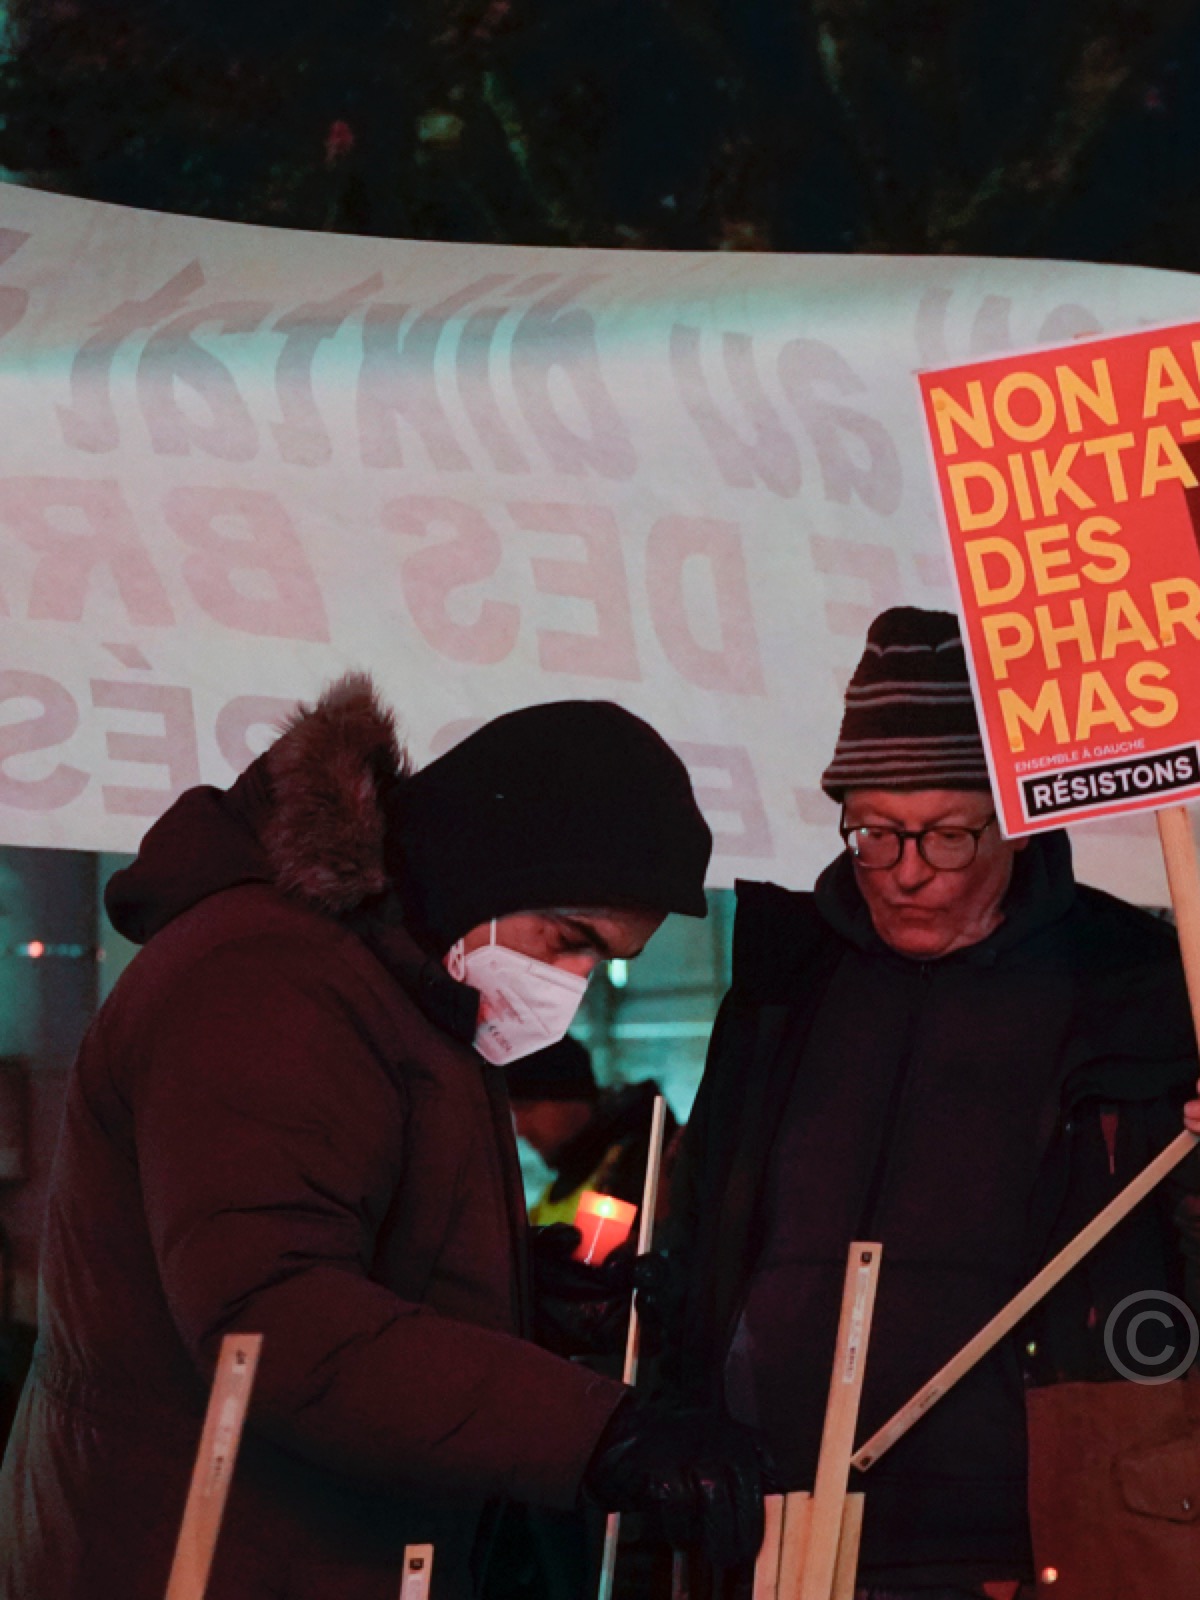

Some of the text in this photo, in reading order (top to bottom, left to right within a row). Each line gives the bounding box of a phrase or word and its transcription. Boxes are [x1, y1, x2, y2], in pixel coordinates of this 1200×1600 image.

[930, 357, 1120, 455] NON
[963, 515, 1131, 607] DES
[997, 660, 1179, 753] MAS
[1014, 752, 1079, 773] ENSEMBLE
[1093, 738, 1145, 757] GAUCHE
[1032, 755, 1193, 809] RÉSISTONS
